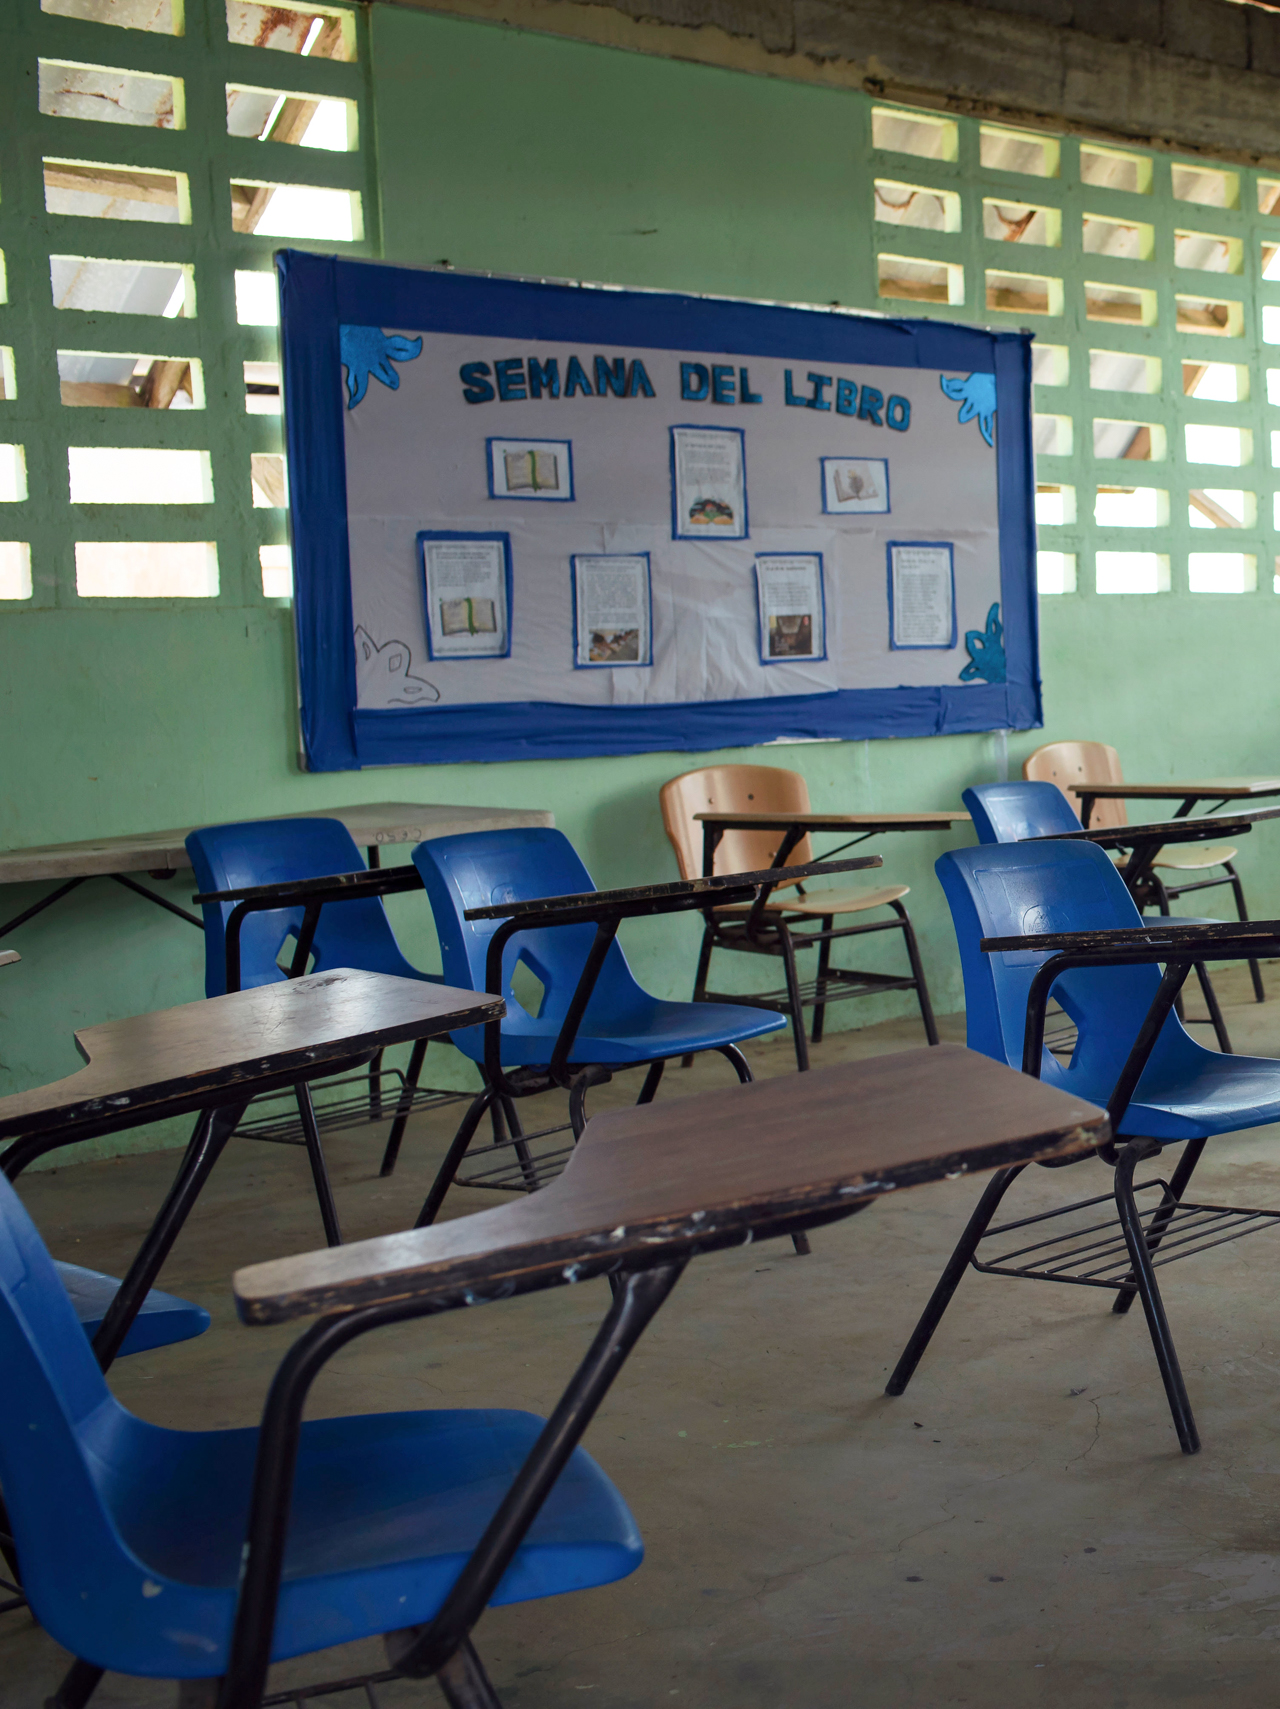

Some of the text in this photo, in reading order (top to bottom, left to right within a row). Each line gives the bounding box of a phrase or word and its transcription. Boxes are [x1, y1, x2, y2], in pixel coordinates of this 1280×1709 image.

[459, 355, 911, 431] SEMANA DEL LIBRO
